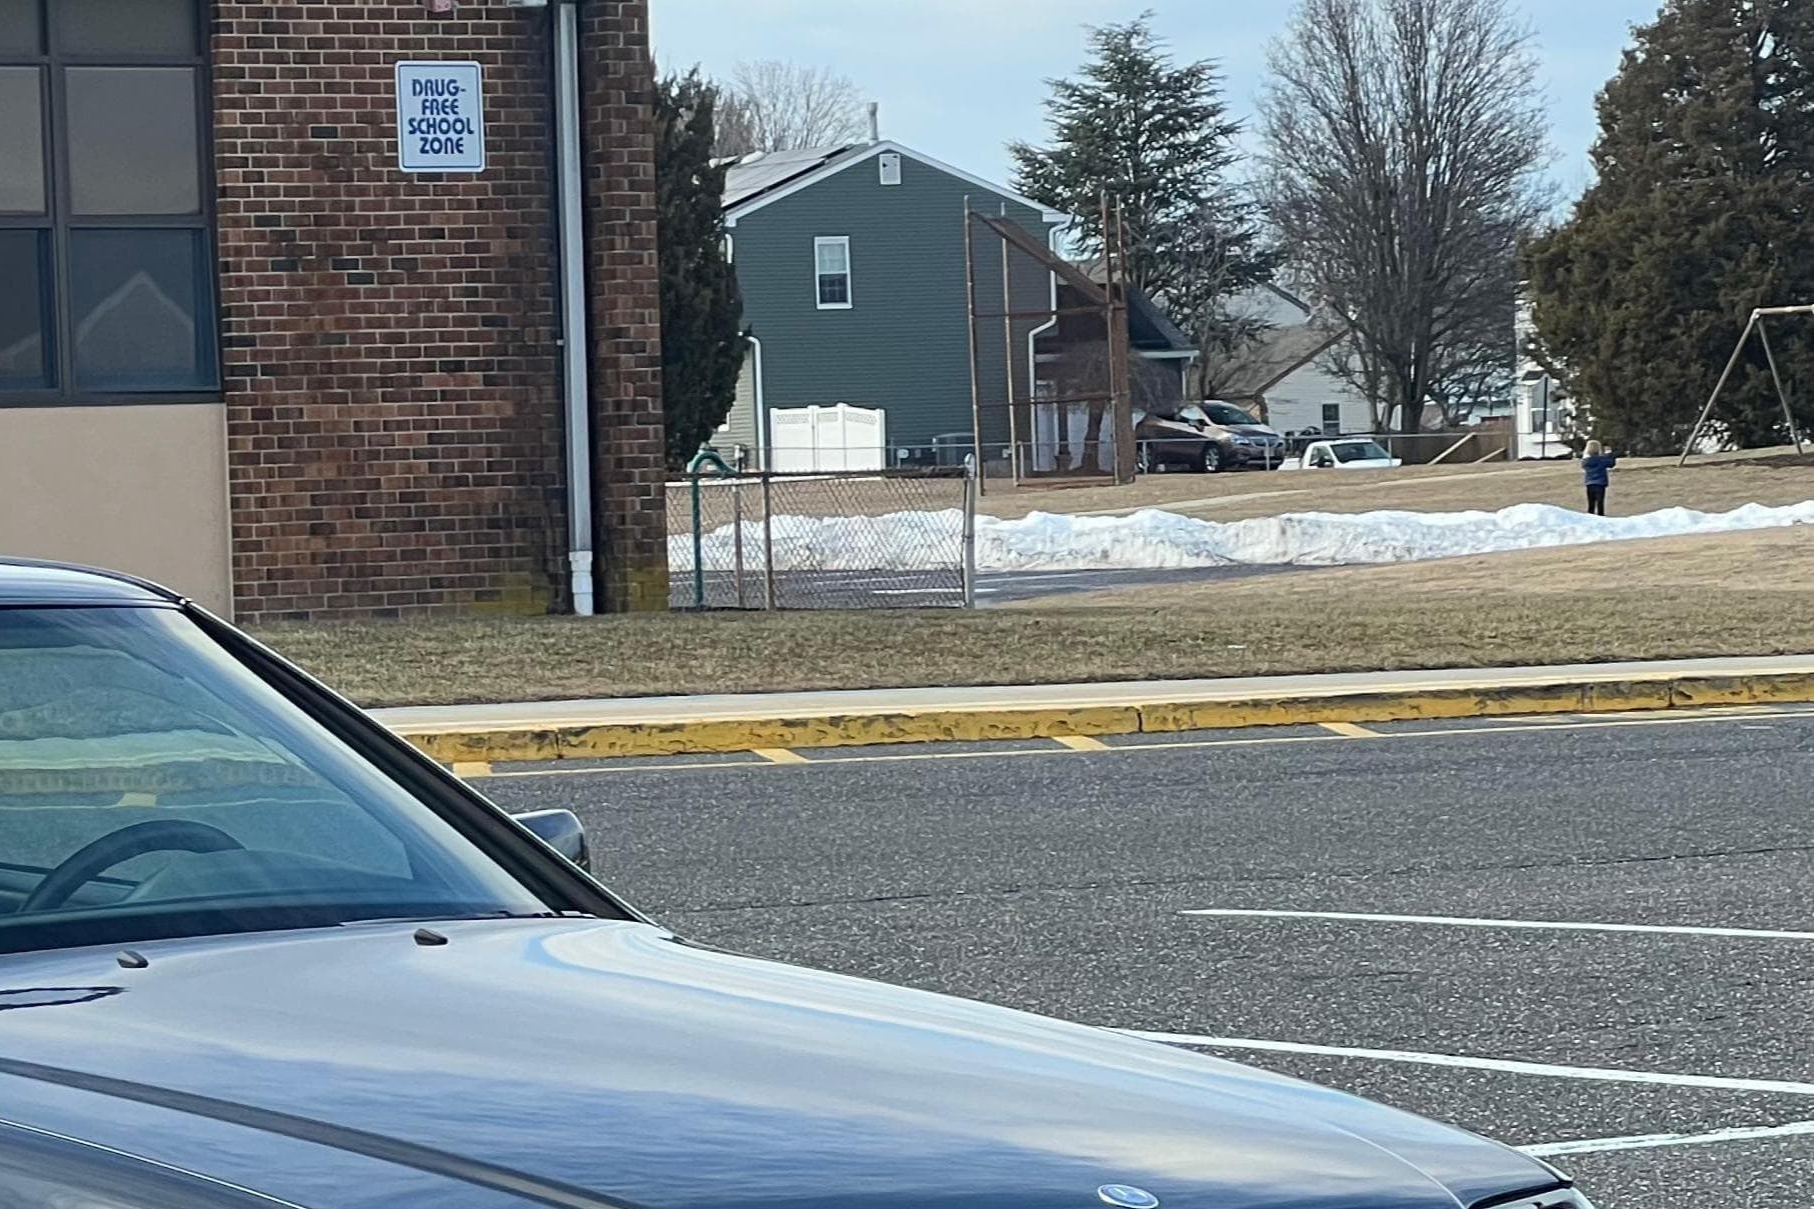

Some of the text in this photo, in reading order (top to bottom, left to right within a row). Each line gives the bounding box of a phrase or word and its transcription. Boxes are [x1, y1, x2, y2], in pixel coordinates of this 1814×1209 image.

[412, 79, 466, 96] DRUG-
[421, 98, 459, 115] FREE
[408, 117, 474, 135] SCHOOL
[419, 137, 464, 154] ZONE
